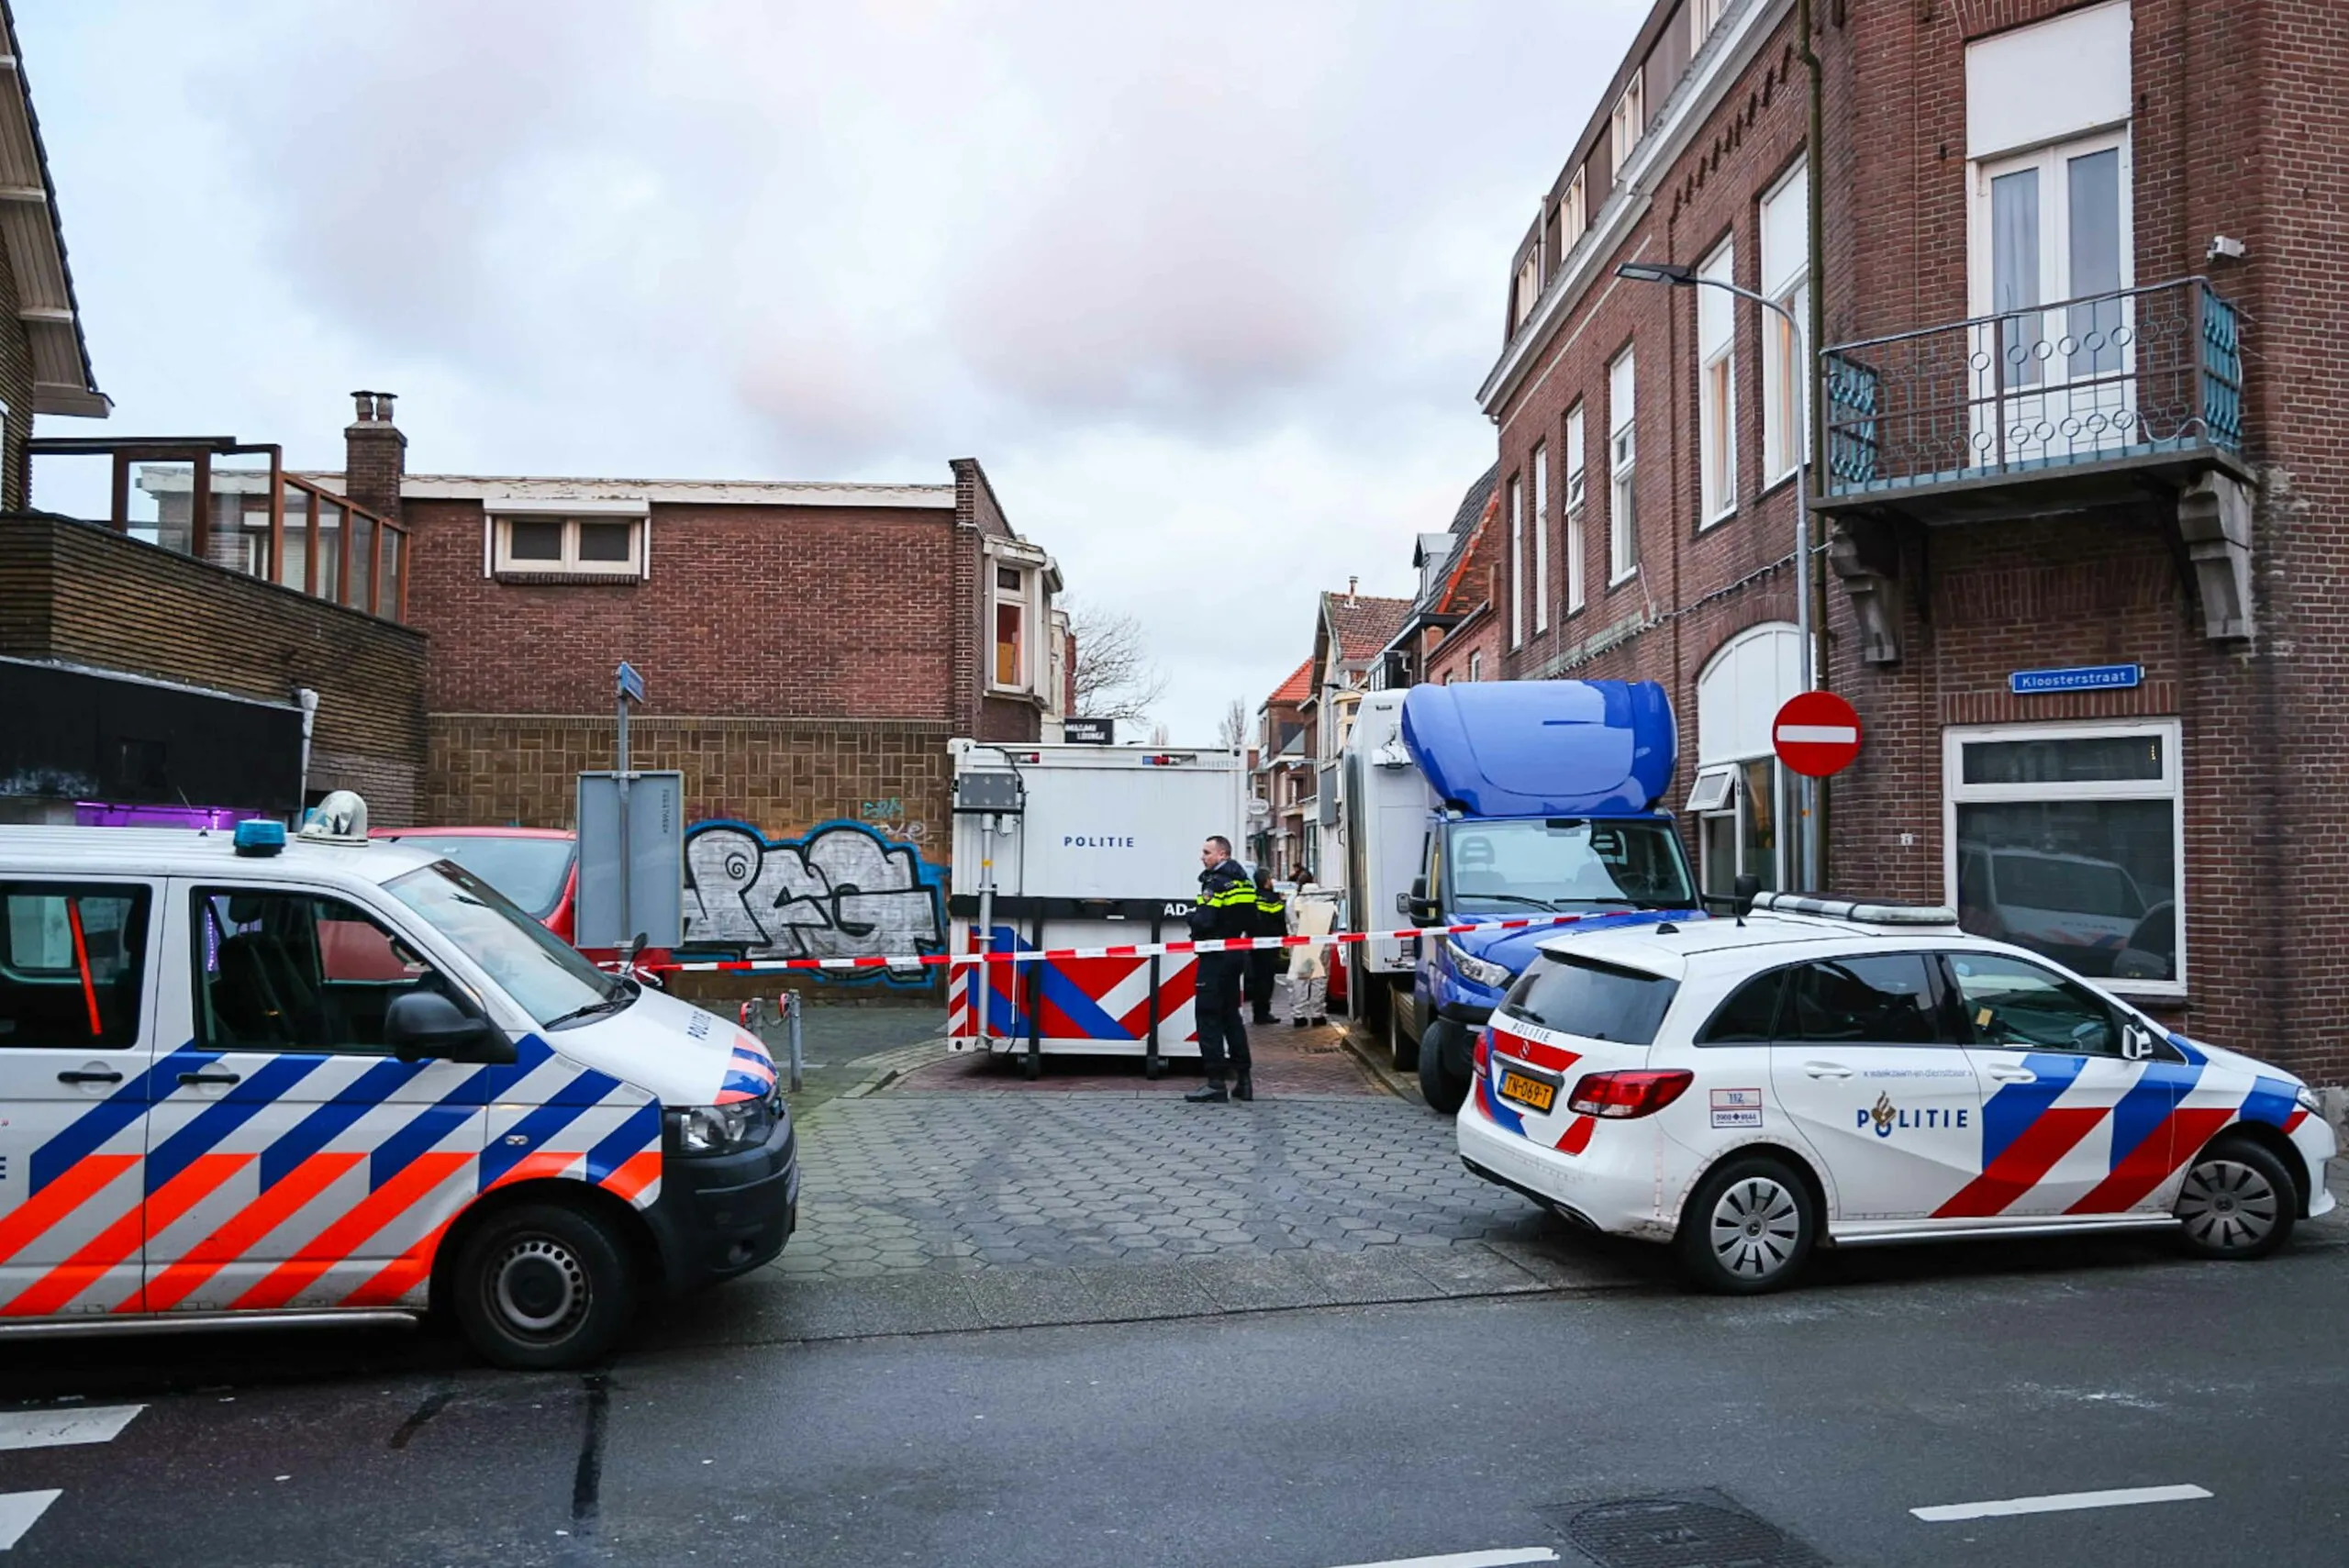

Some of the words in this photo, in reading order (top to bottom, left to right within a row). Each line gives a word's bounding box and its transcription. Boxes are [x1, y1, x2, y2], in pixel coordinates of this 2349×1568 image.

[2021, 671, 2127, 688] Kloosterstraat
[1063, 836, 1134, 848] POLITIE
[1512, 1022, 1552, 1043] POLITIE
[1507, 1075, 1551, 1106] TN-069-T
[1856, 1108, 1968, 1139] POLITIE
